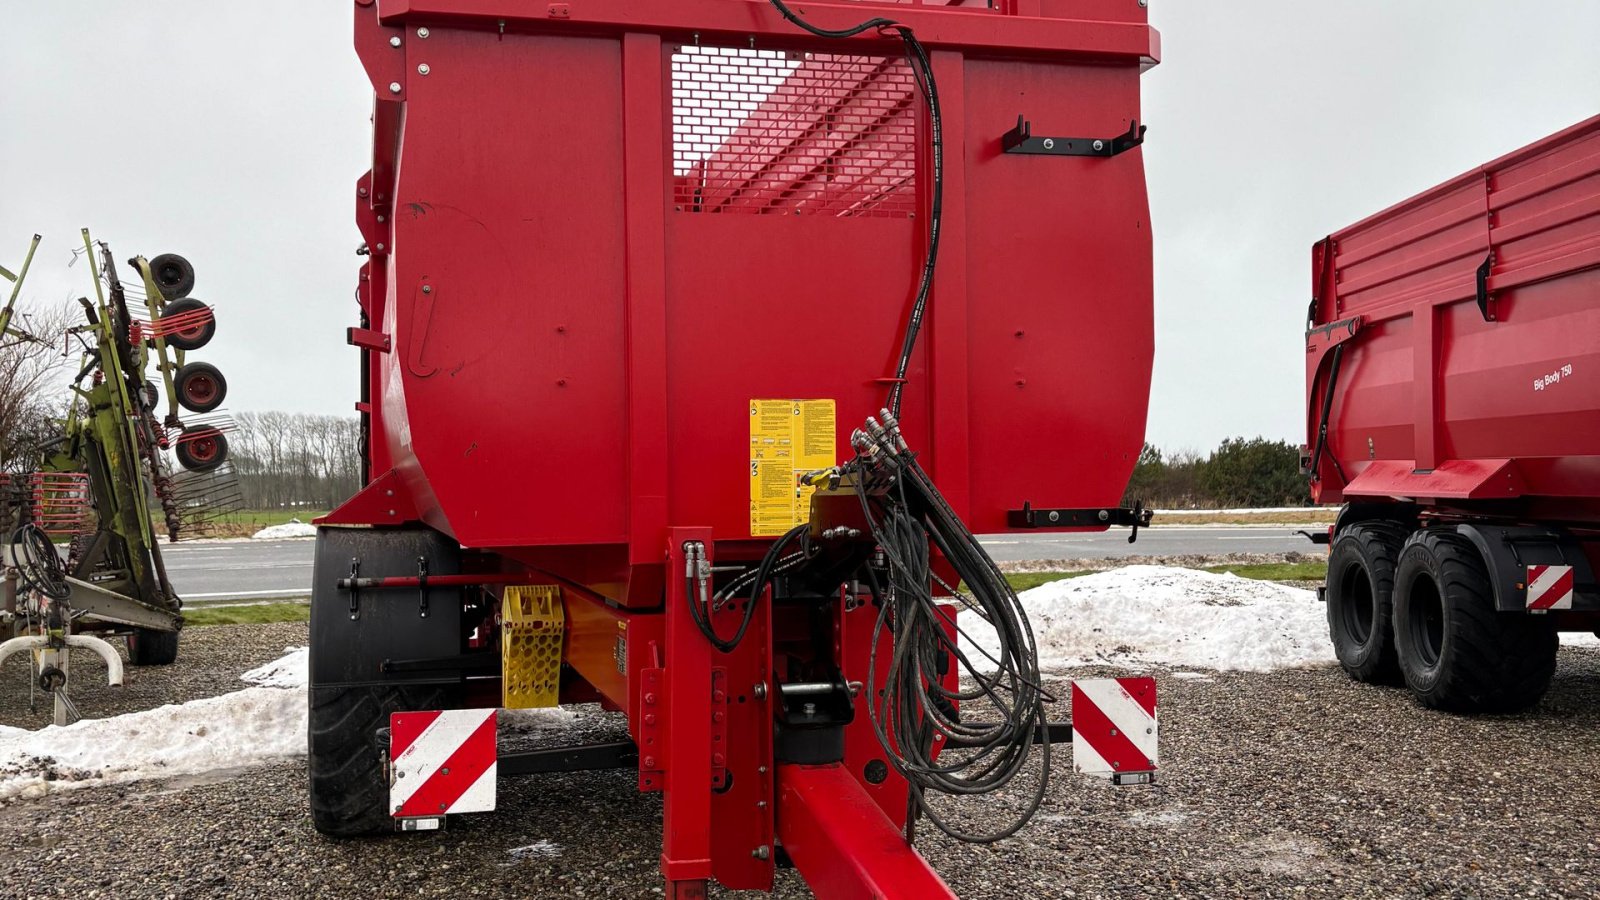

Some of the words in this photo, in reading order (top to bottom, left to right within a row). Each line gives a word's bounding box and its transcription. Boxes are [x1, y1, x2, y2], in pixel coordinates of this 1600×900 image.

[1534, 379, 1544, 391] Big
[1545, 370, 1560, 386] Body
[1560, 364, 1572, 378] 750
